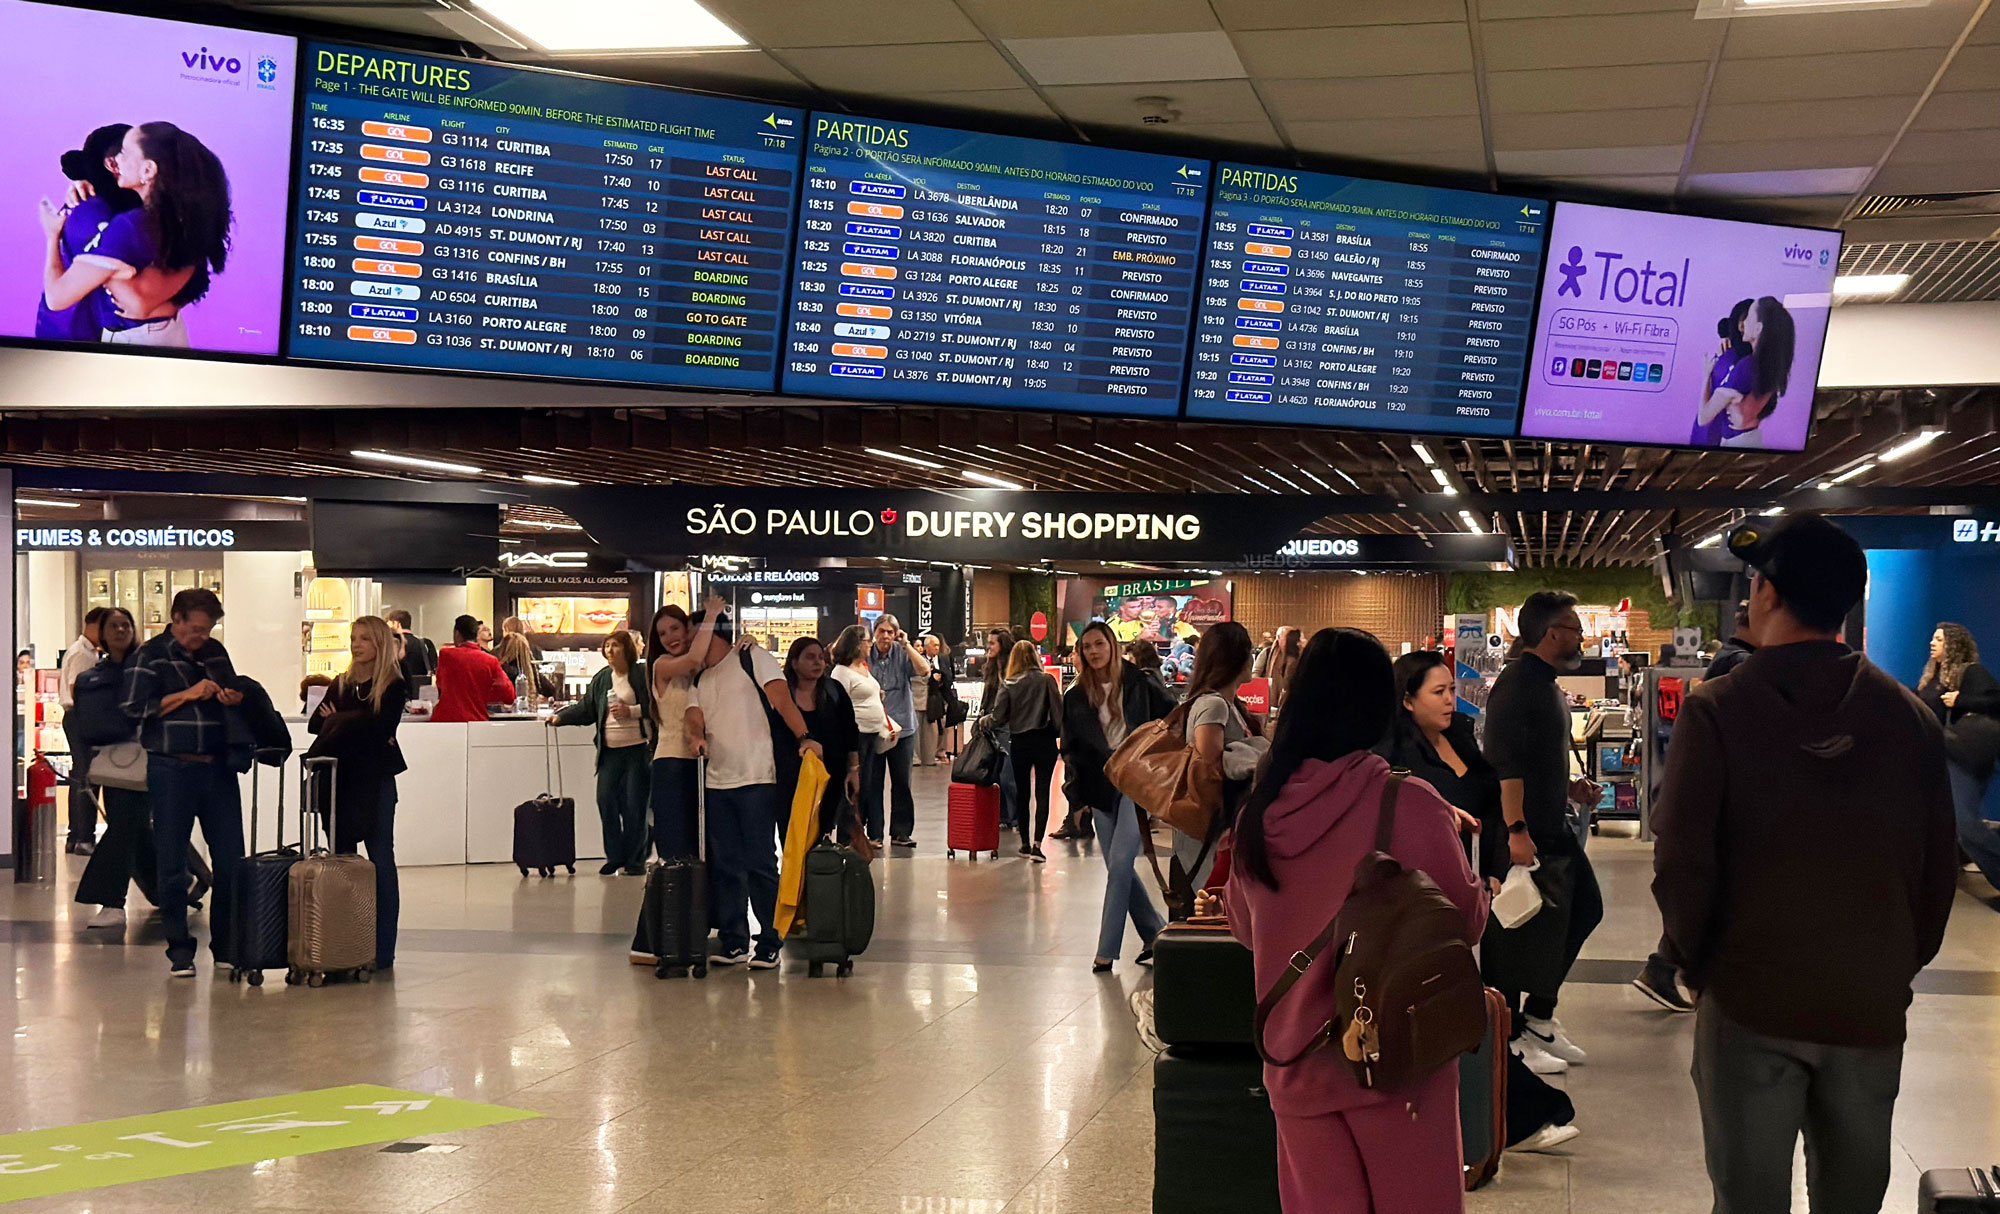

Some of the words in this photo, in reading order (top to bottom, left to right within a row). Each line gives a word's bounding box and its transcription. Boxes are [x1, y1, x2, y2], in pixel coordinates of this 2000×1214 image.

[182, 46, 241, 74] vivo
[317, 50, 470, 90] DEPARTURES
[315, 77, 340, 93] Page
[358, 83, 379, 96] THE
[381, 86, 409, 100] GATE
[410, 90, 435, 103] WILL
[438, 93, 451, 105] BE
[453, 96, 507, 112] INFORMED
[508, 103, 543, 117] 90MIN.
[545, 108, 583, 122] BEFORE
[585, 113, 604, 125] THE
[605, 116, 658, 132] ESTIMATED
[659, 123, 692, 136] FLIGHT
[694, 127, 715, 139] TIME
[310, 102, 328, 112] TIME
[383, 112, 410, 122] AIRLINE
[441, 119, 466, 129] FLIGHT
[495, 126, 510, 134] CITY
[603, 139, 638, 150] ESTIMATED
[648, 145, 664, 154] GATE
[722, 154, 745, 163] STATUS
[312, 117, 345, 131] 16:35
[386, 126, 408, 139] GOL
[442, 133, 458, 145] G3
[461, 135, 488, 148] 1114
[496, 140, 551, 156] CURITIBA
[605, 153, 633, 166] 17:50
[650, 158, 662, 169] 17
[706, 165, 732, 177] LAST
[732, 168, 758, 181] CALL
[816, 119, 909, 148] PARTIDAS
[311, 140, 344, 154] 17:35
[384, 149, 406, 162] GOL
[440, 156, 456, 167] G3
[459, 158, 486, 171] 1618
[495, 162, 534, 176] RECIFE
[603, 175, 631, 188] 17:40
[648, 180, 660, 191] 10
[704, 186, 730, 198] LAST
[730, 190, 756, 202] CALL
[1221, 168, 1298, 193] PARTIDAS
[308, 186, 340, 200] 17:45
[379, 196, 414, 206] LATAM
[437, 200, 452, 212] LA
[453, 202, 481, 215] 3124
[491, 206, 554, 224] LONDRINA
[599, 218, 627, 231] 17:50
[642, 223, 656, 234] 03
[700, 229, 725, 240] LAST
[726, 232, 751, 244] CALL
[808, 199, 834, 210] 18:15
[867, 204, 884, 216] GOL
[911, 210, 925, 220] G3
[927, 211, 949, 223] 1636
[954, 212, 1006, 228] SALVADOR
[1043, 224, 1066, 235] 18:15
[1079, 227, 1090, 237] 18
[1126, 232, 1167, 245] PREVISTO
[1215, 222, 1237, 232] 18:55
[1261, 227, 1285, 235] LATAM
[1300, 231, 1310, 240] LA
[1310, 231, 1329, 242] 3581
[1336, 234, 1372, 246] BRASÍLIA
[1409, 242, 1428, 252] 18:55
[1470, 248, 1520, 262] CONFIRMADO
[1784, 243, 1813, 260] vivo
[804, 240, 830, 252] 18:25
[860, 247, 889, 255] LATAM
[907, 250, 919, 260] LA
[920, 251, 943, 262] 3088
[950, 254, 1026, 270] FLORIANÓPOLIS
[1039, 263, 1061, 274] 18:35
[1075, 266, 1084, 276] 11
[1121, 270, 1162, 283] PREVISTO
[1210, 259, 1232, 270] 18:55
[1295, 267, 1305, 277] LA
[1306, 268, 1325, 279] 3696
[1331, 271, 1383, 284] NAVEGANTES
[1404, 278, 1424, 288] 18:55
[1473, 284, 1508, 296] PREVISTO
[1594, 251, 1690, 307] Total
[801, 260, 828, 272] 18:25
[860, 265, 879, 276] GOL
[904, 270, 918, 280] G3
[920, 272, 942, 282] 1284
[948, 274, 981, 286] PORTO
[982, 277, 1018, 290] ALEGRE
[1036, 282, 1059, 293] 18:25
[1071, 285, 1083, 295] 02
[1110, 289, 1169, 302] CONFIRMADO
[302, 278, 334, 291] 18:00
[368, 285, 392, 296] Azul
[429, 290, 447, 301] AD
[449, 291, 477, 304] 6504
[484, 294, 538, 309] CURITIBA
[591, 304, 619, 316] 18:00
[634, 307, 648, 318] 08
[686, 312, 703, 323] GO
[704, 313, 719, 324] TO
[721, 315, 747, 327] GATE
[1558, 318, 1574, 330] 5G
[1576, 318, 1596, 332] Pós
[1615, 321, 1641, 335] Wi-Fi
[1644, 324, 1670, 337] Fibra
[1194, 389, 1215, 398] 19:20
[1278, 394, 1288, 403] LA
[1288, 395, 1308, 405] 4620
[1314, 397, 1376, 409] FLORIANÓPOLIS
[1387, 402, 1406, 411] 19:20
[1456, 406, 1490, 416] PREVISTO
[16, 528, 83, 546] FUMES
[88, 529, 102, 546] &
[106, 526, 234, 546] COSMÉTICOS
[686, 504, 757, 536] SÃO
[767, 508, 874, 536] PAULO
[906, 511, 1016, 538] DUFRY
[1022, 512, 1200, 540] SHOPPING
[1276, 540, 1359, 555] QUEDOS
[754, 572, 761, 581] E
[764, 569, 819, 582] RELÓGIOS
[1122, 580, 1186, 596] BRASIL
